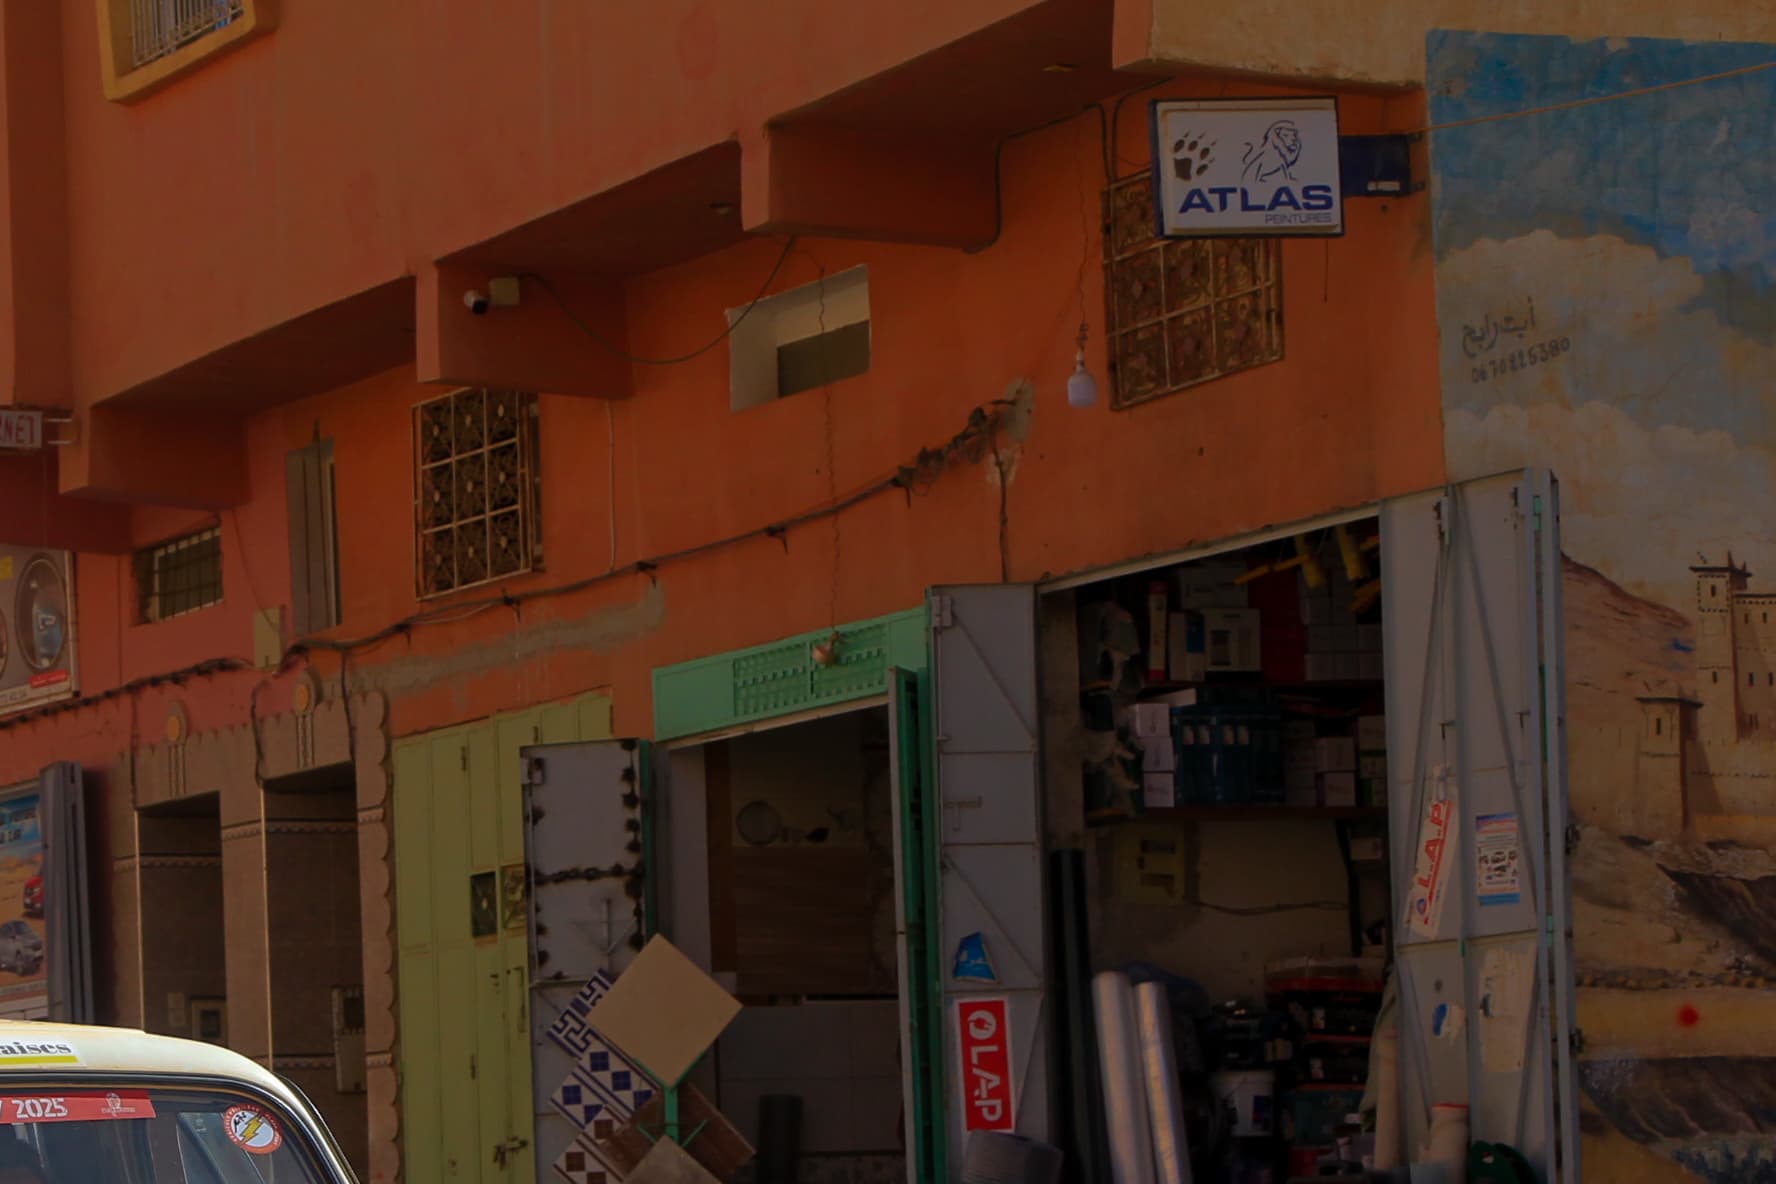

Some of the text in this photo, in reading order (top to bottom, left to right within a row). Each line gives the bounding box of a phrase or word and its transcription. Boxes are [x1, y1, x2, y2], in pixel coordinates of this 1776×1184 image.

[1179, 184, 1334, 213] ATLAS
[1264, 212, 1333, 225] PEINTURES
[967, 1008, 1004, 1123] OLAP
[12, 1097, 69, 1119] 2025
